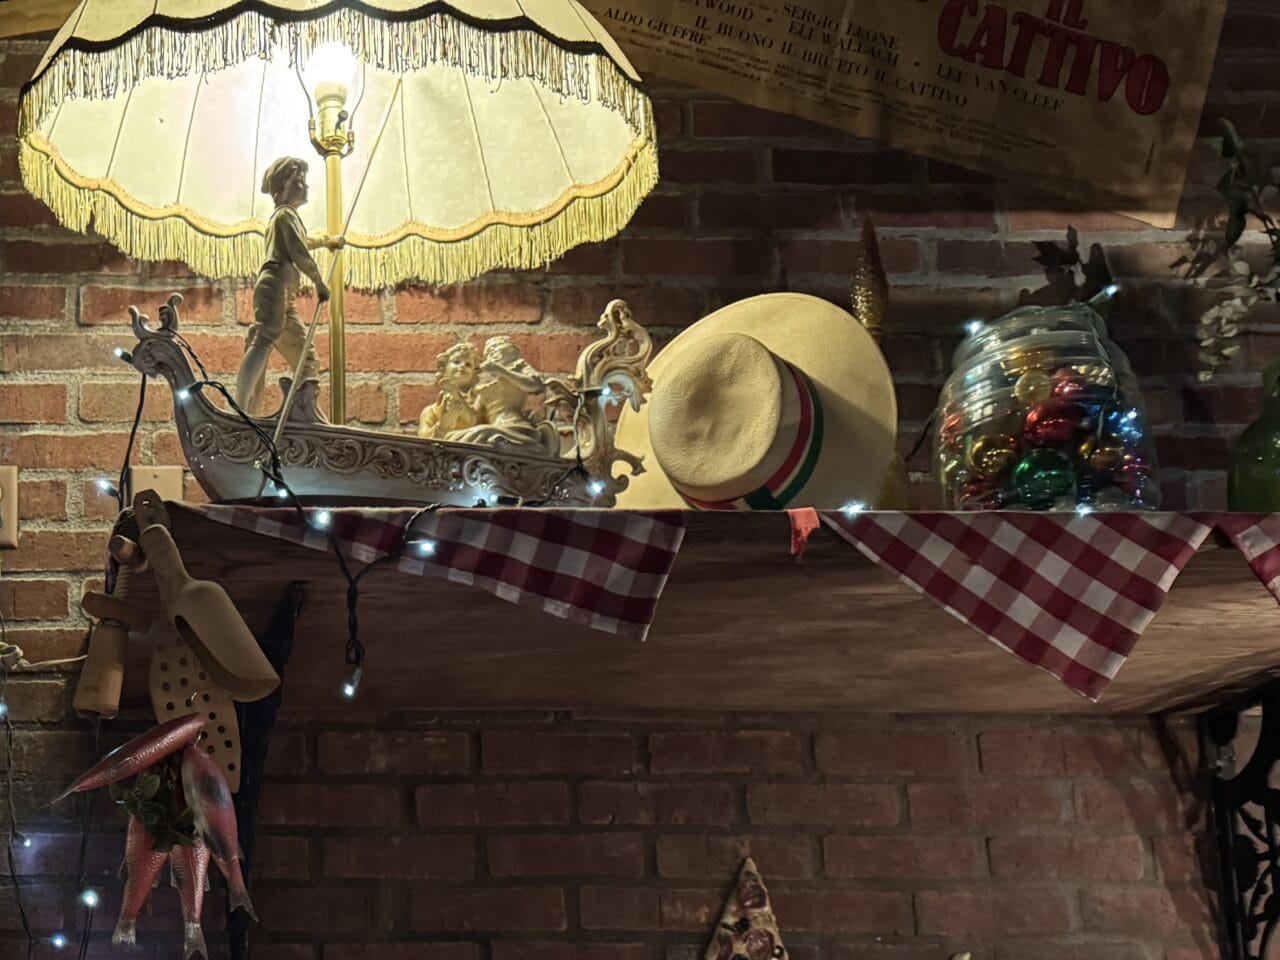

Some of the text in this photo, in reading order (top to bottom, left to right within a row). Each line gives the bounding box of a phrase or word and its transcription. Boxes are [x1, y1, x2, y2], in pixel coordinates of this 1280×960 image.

[603, 7, 643, 27] ALDO
[782, 3, 840, 31] SERGIO
[694, 15, 713, 31] IL
[716, 22, 775, 50] BUONO
[895, 76, 968, 108] CATTIVO
[937, 0, 1170, 116] CATTIVO
